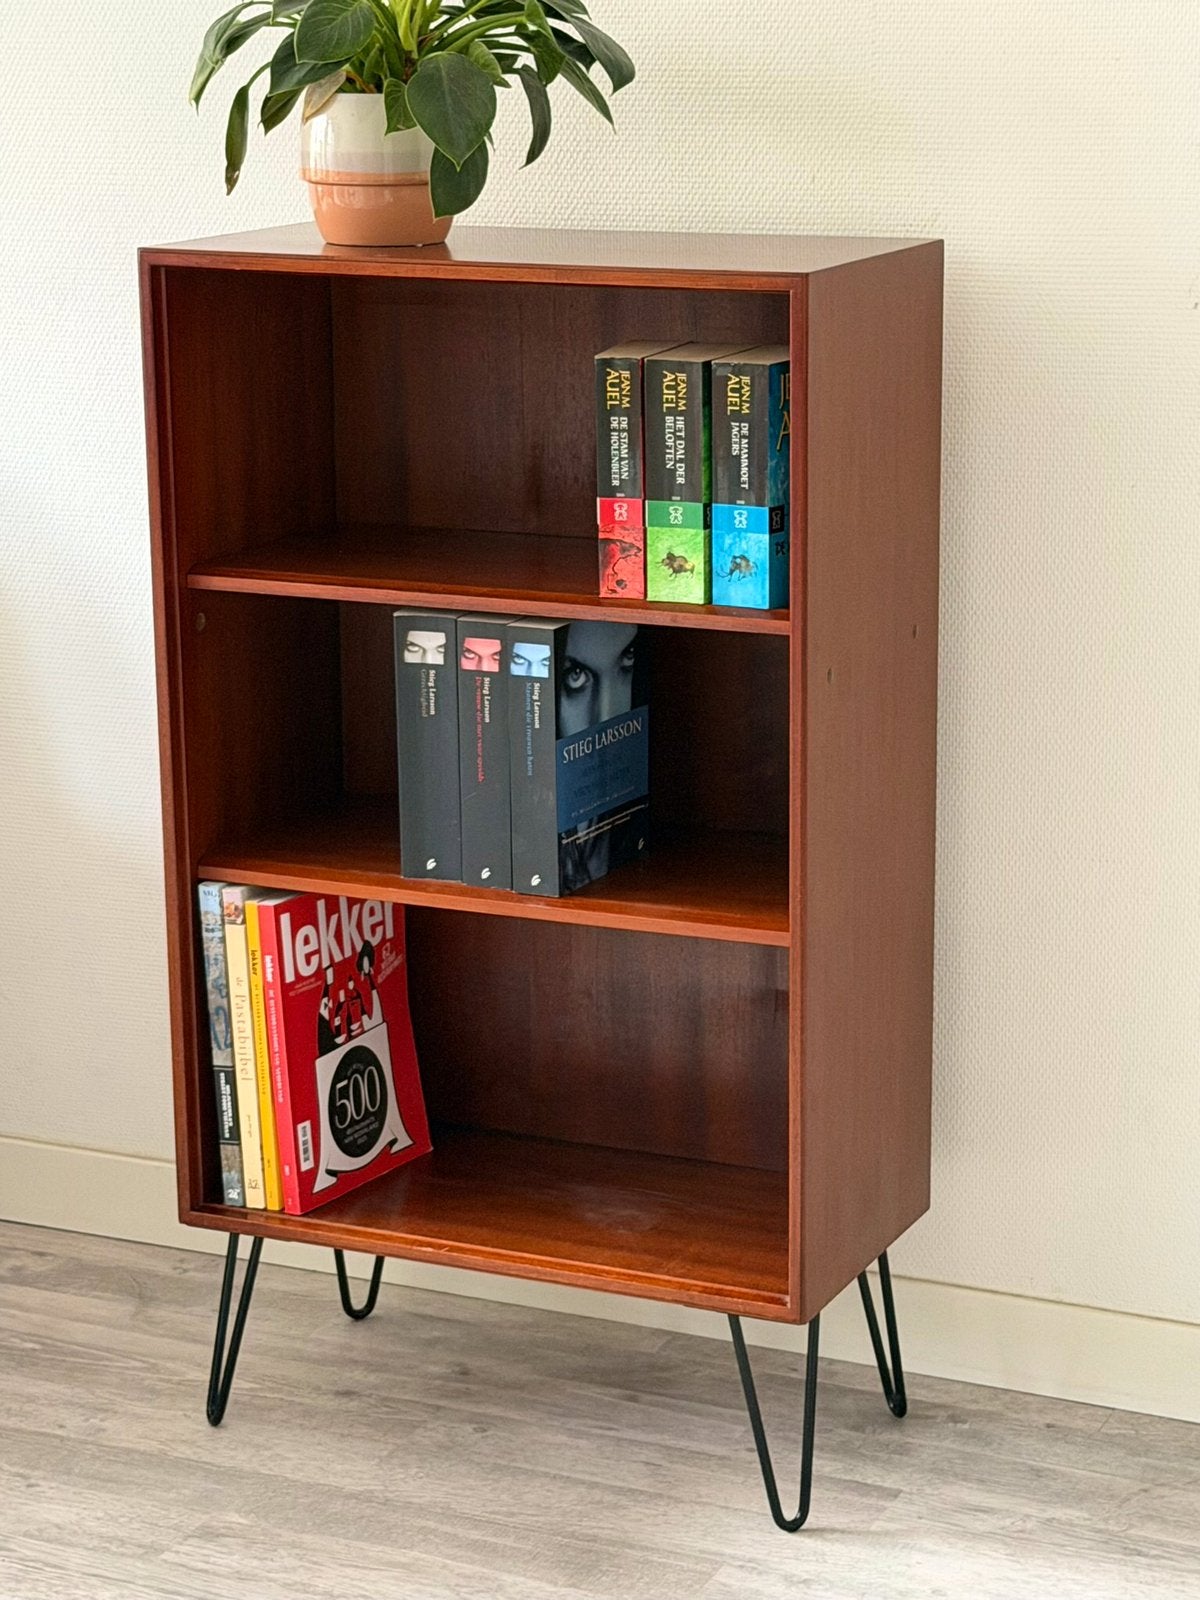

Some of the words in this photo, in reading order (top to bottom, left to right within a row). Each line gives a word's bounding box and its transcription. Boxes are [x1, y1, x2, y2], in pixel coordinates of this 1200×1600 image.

[606, 368, 620, 410] AUEL
[620, 370, 630, 394] JEAN
[662, 370, 676, 412] AUEL
[676, 372, 686, 398] JEAN
[740, 376, 750, 400] JEAN
[622, 397, 630, 408] M
[678, 399, 687, 410] M
[727, 374, 740, 415] AUEL
[742, 402, 750, 414] M
[610, 416, 619, 430] DE
[620, 416, 628, 430] DE
[676, 416, 685, 438] HET
[740, 422, 748, 436] DE
[620, 432, 628, 457] STAM
[665, 416, 674, 469] BELOFTEN
[676, 440, 685, 460] DAL
[730, 422, 739, 456] JAGERS
[611, 432, 619, 486] HOLENBEER
[620, 460, 629, 479] VAN
[740, 438, 749, 489] MAMMOET
[676, 463, 685, 484] DER
[428, 670, 436, 687] Stieg
[532, 682, 541, 700] Stieg
[563, 736, 592, 764] STIEG
[595, 717, 642, 750] LARSSON
[236, 977, 244, 987] de
[235, 995, 252, 1081] Pastabijbel
[335, 1066, 380, 1129] 500
